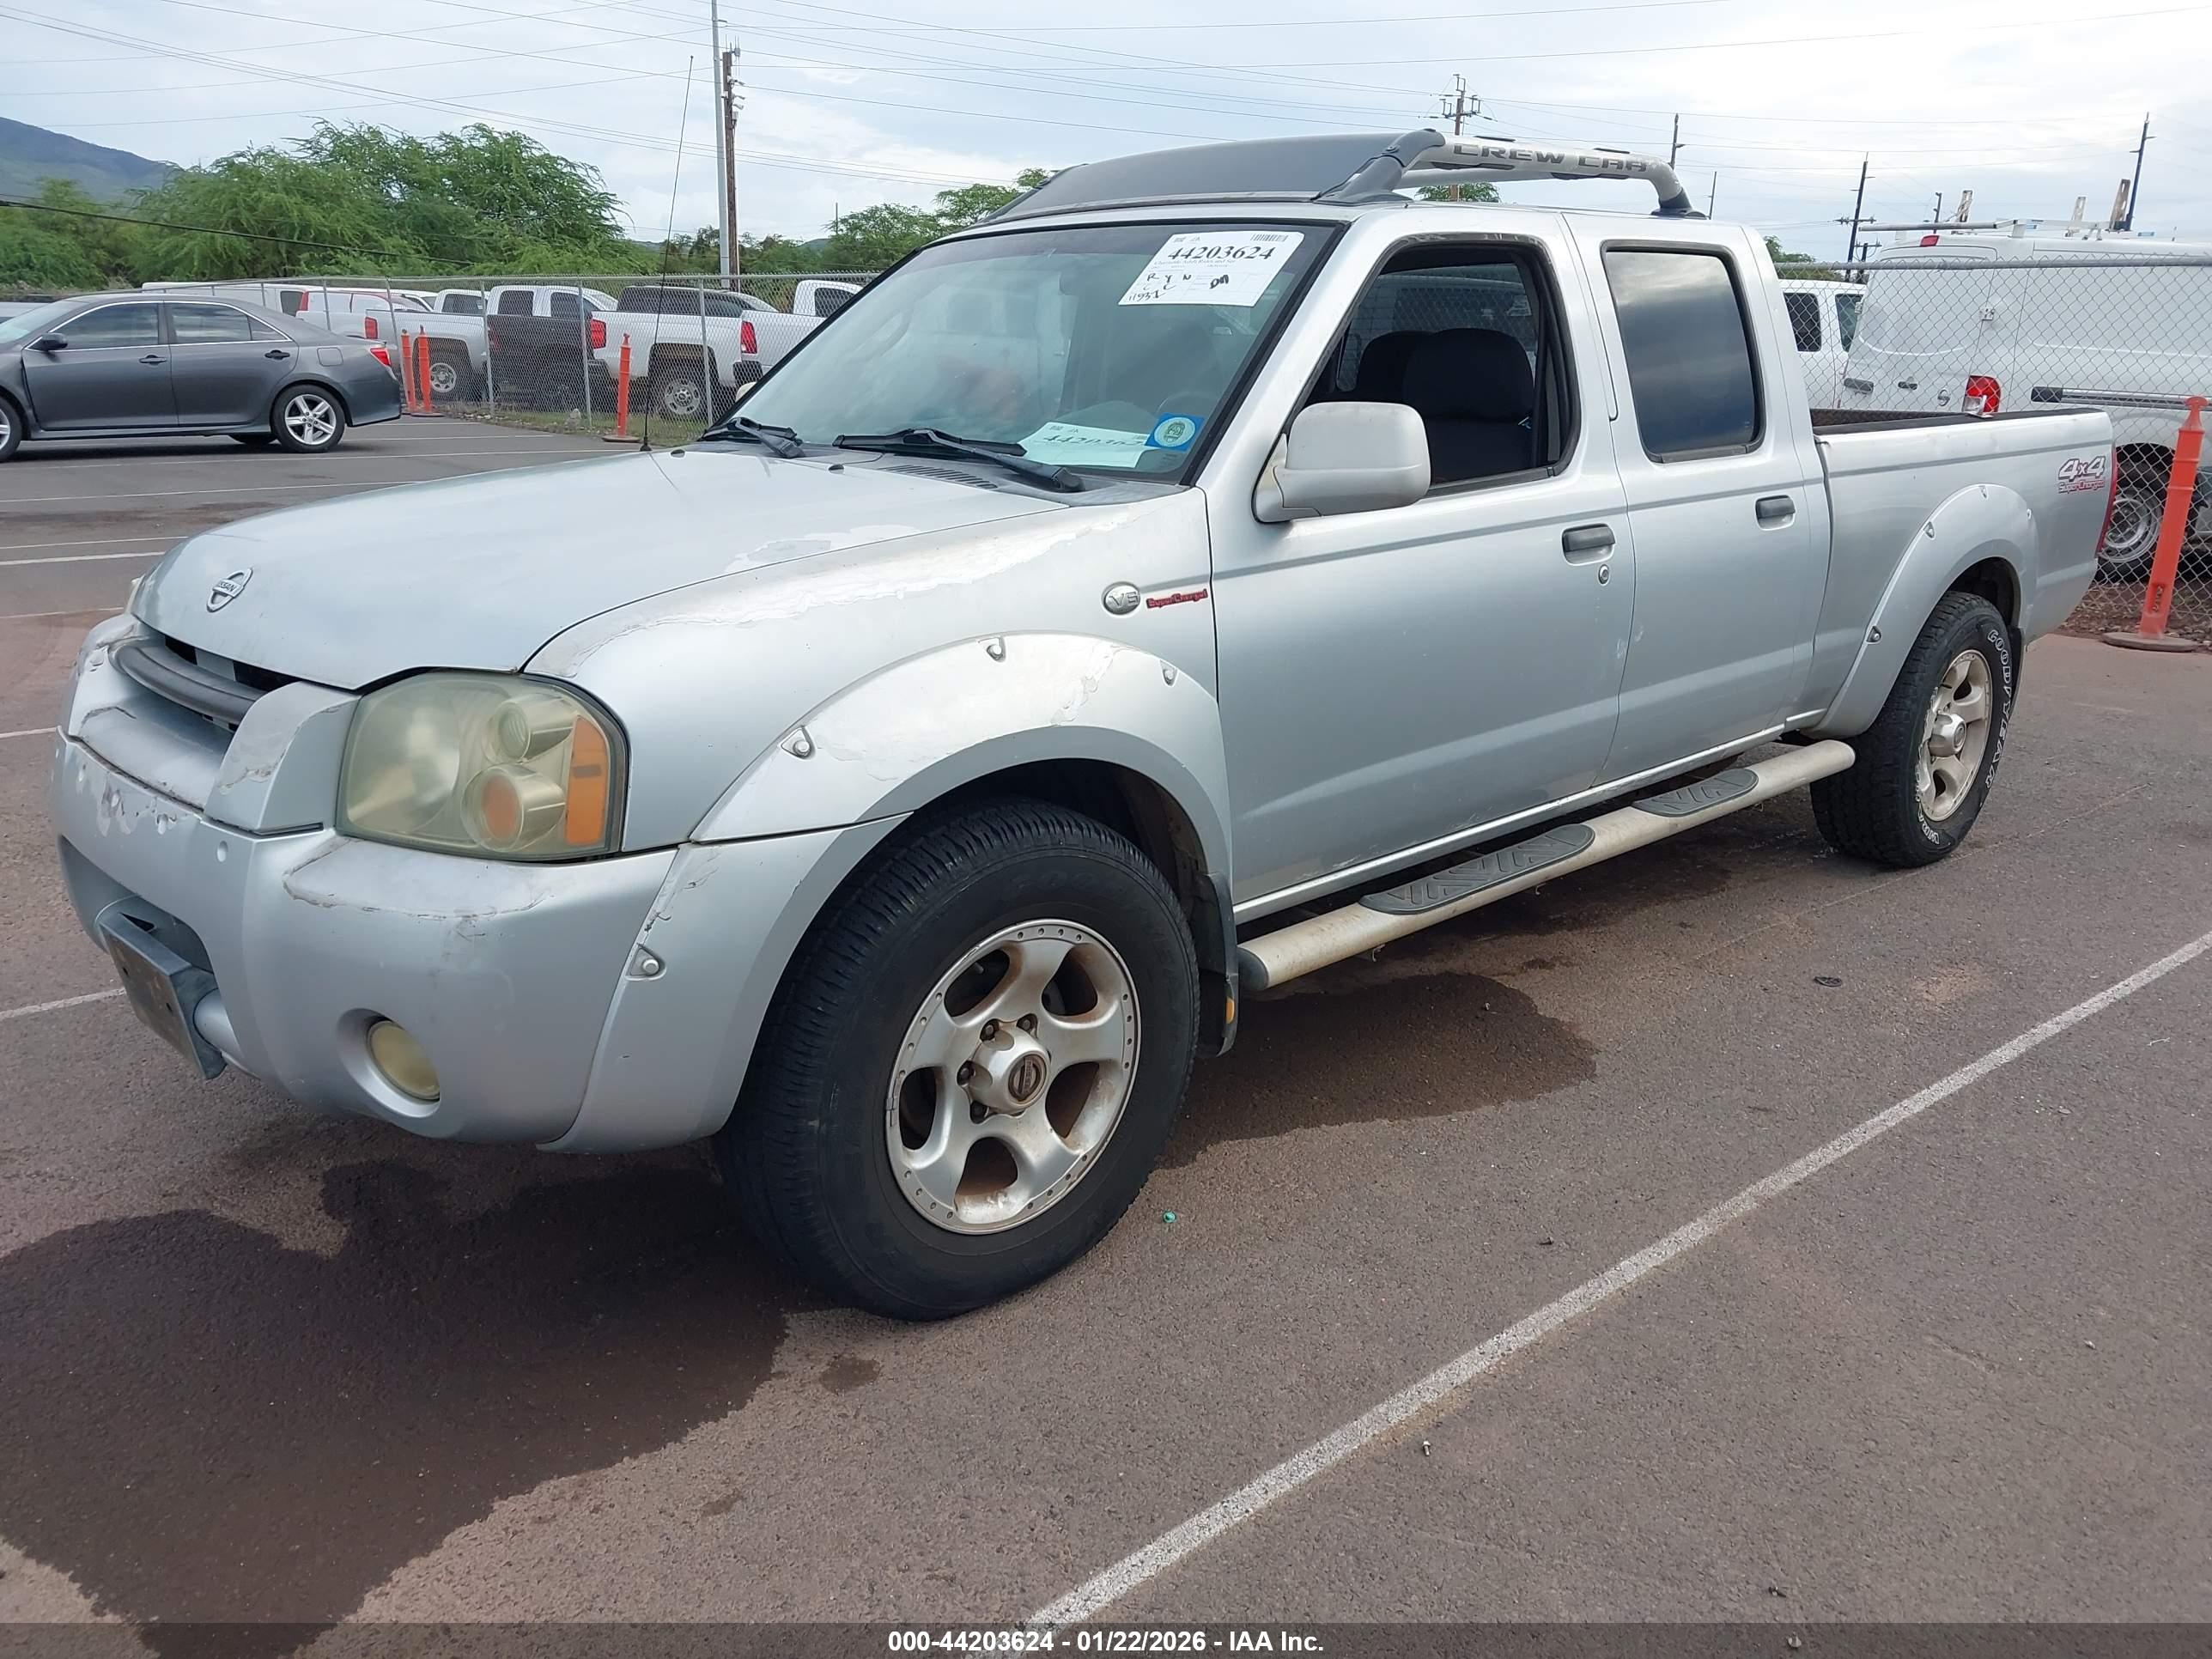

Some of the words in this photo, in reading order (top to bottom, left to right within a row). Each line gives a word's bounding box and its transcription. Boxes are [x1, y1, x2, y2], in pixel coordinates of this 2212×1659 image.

[1453, 143, 1566, 165] CREW
[1167, 246, 1276, 260] 44203624
[2057, 455, 2106, 483] 4x4
[1985, 629, 2013, 789] GOODYEAR
